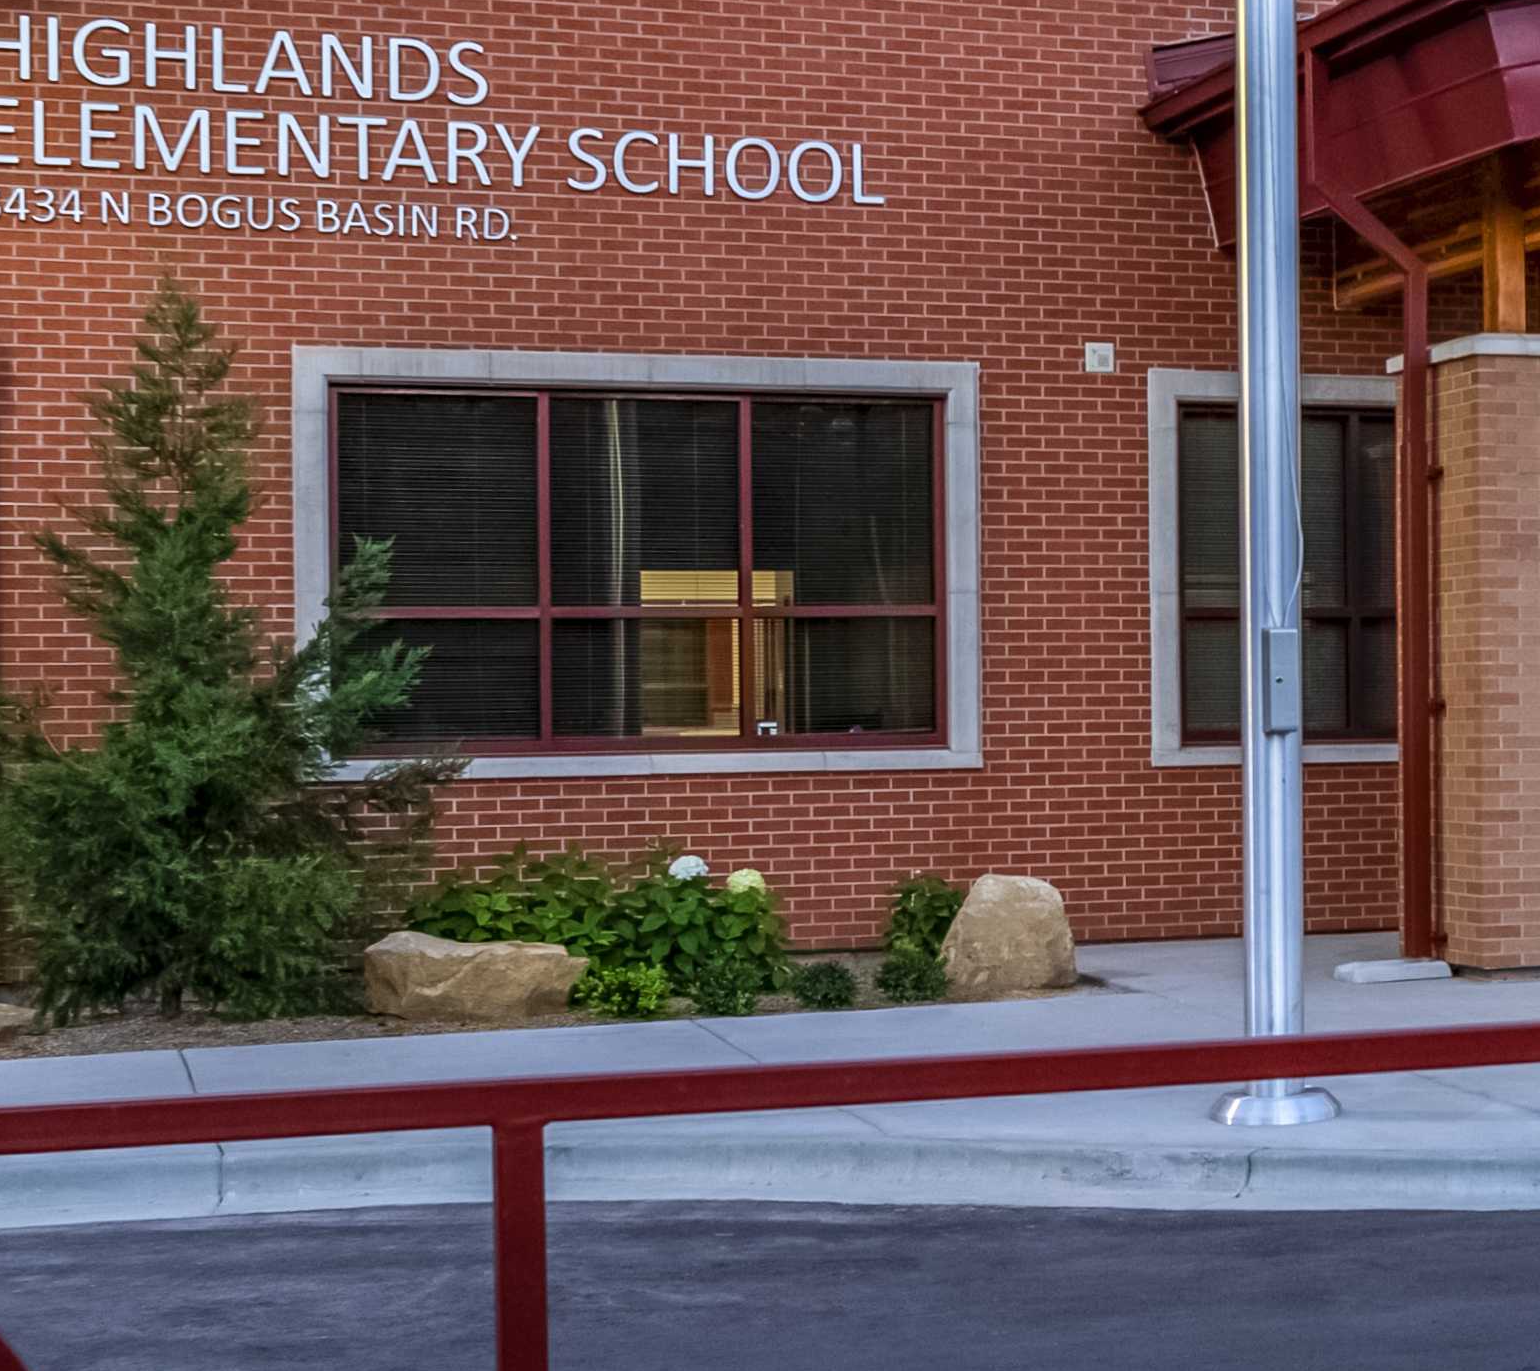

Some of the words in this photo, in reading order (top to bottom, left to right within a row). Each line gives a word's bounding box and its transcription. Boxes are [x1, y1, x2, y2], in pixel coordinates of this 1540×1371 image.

[566, 127, 887, 205] SCHOOL
[98, 190, 131, 224] N
[146, 192, 302, 232] BOGUS
[315, 197, 439, 239] BASIN
